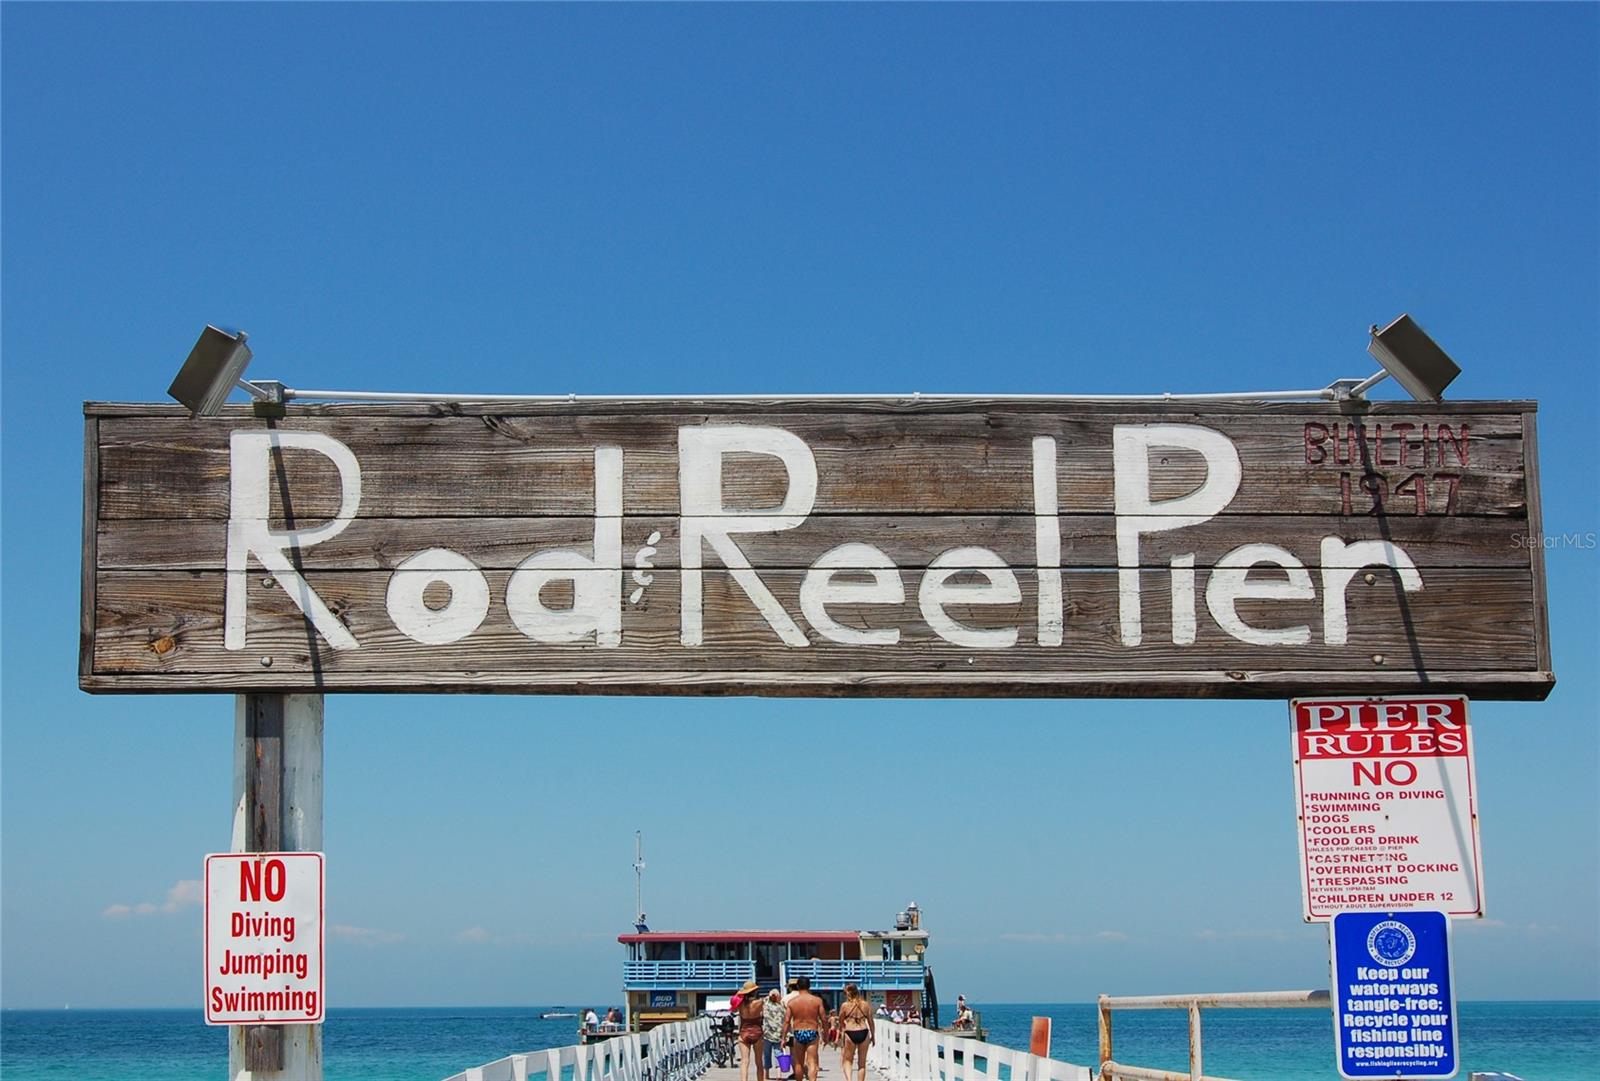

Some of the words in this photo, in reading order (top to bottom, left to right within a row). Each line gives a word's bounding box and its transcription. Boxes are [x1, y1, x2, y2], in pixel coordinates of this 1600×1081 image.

[1341, 472, 1462, 516] 1947
[224, 428, 624, 650] Rod
[677, 423, 1064, 650] Reel
[1112, 422, 1424, 649] Pier
[1303, 704, 1461, 732] PIER
[1304, 733, 1463, 755] RULES
[1353, 761, 1417, 786] NO
[1310, 792, 1370, 801] RUNNING
[1376, 791, 1394, 799] OR
[1399, 791, 1444, 799] DIVING
[1311, 803, 1380, 812] SWIMMING
[1312, 815, 1349, 823] DOGS
[1313, 826, 1375, 834] COOLERS
[1314, 838, 1349, 846] FOOD
[1355, 836, 1373, 845] OR
[1379, 836, 1419, 844] DRINK
[1316, 865, 1392, 875] OVERNIGHT
[1398, 864, 1458, 873] DOCKING
[240, 859, 286, 902] NO
[1317, 876, 1408, 886] TRESPASSING
[1318, 894, 1384, 903] CHILDREN
[1390, 893, 1434, 901] UNDER
[232, 912, 295, 942] Diving
[220, 949, 307, 979] Jumping
[1357, 967, 1398, 981] Keep
[1402, 968, 1429, 979] our
[1350, 983, 1438, 996] waterways
[212, 986, 316, 1016] Swimming
[1347, 998, 1442, 1012] tangle-free;
[1344, 1013, 1408, 1027] Recycle
[1411, 1014, 1448, 1027] your
[1351, 1029, 1407, 1043] fishing
[1411, 1028, 1442, 1041] line
[1348, 1044, 1448, 1059] responsibly.
